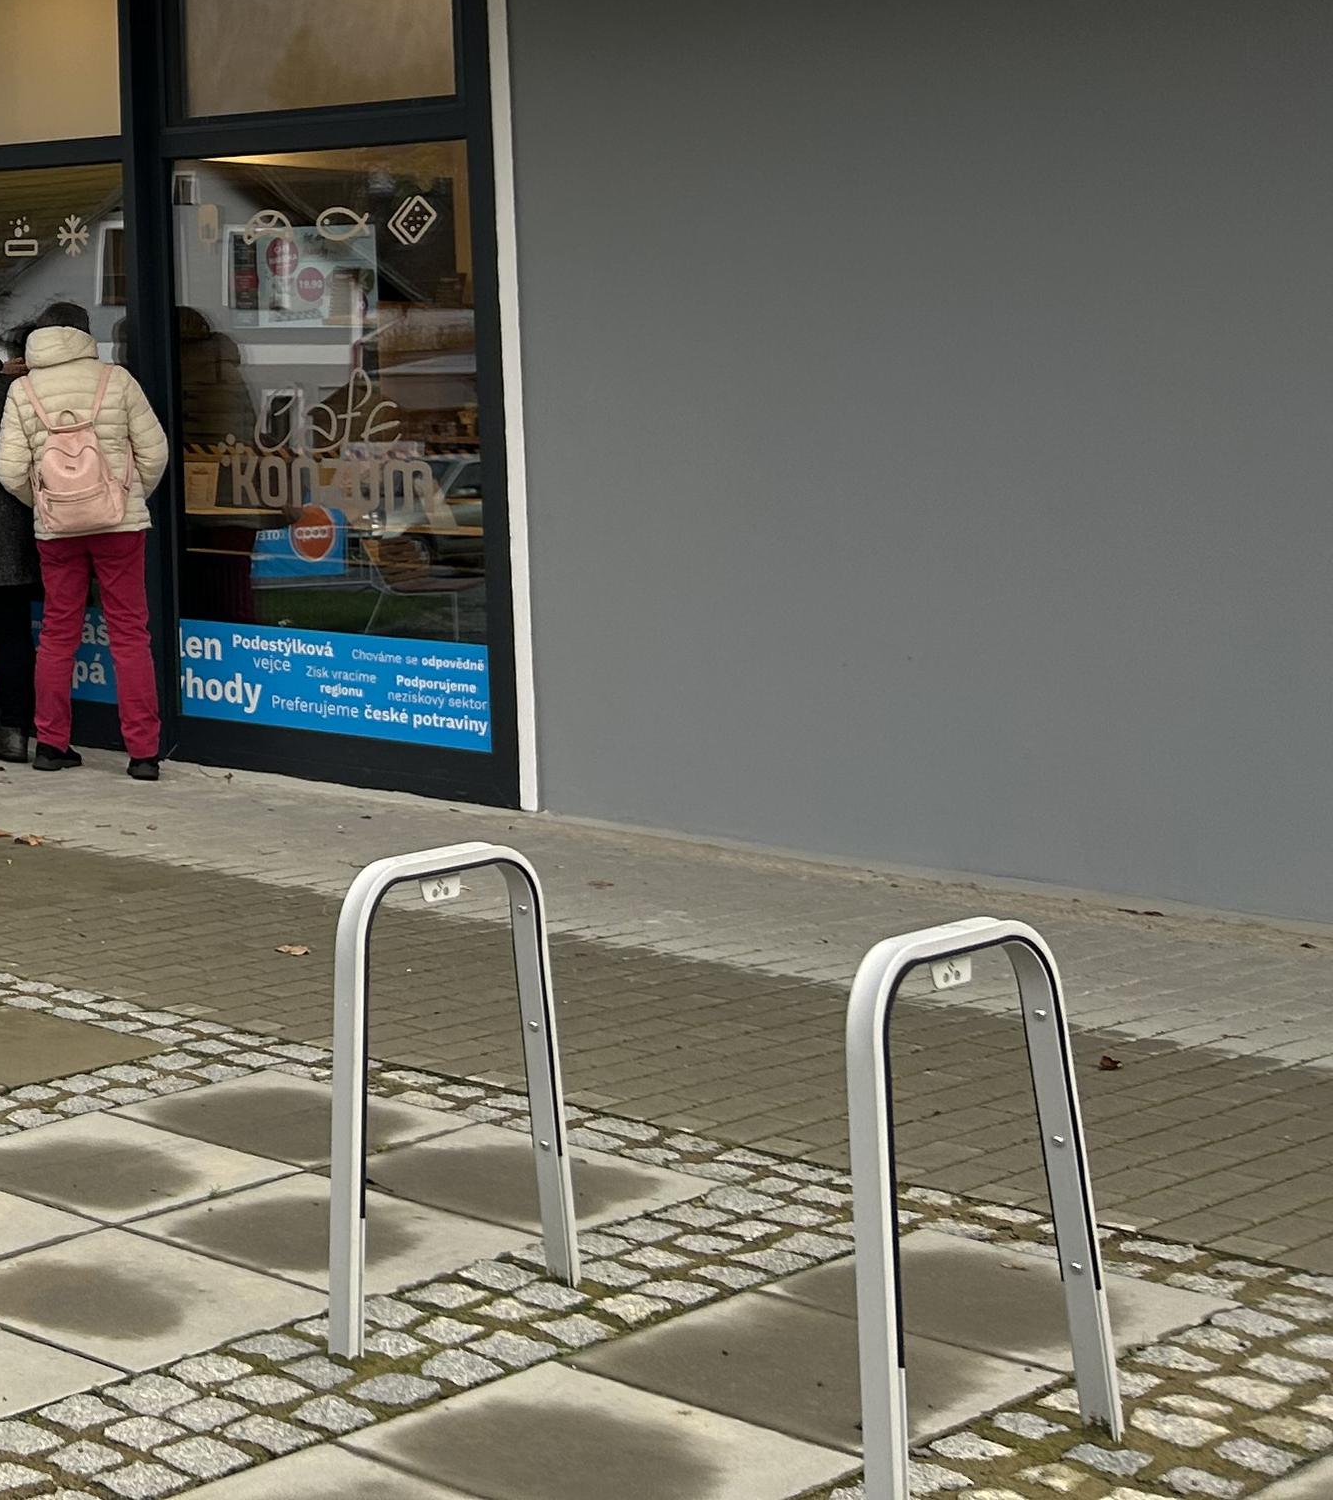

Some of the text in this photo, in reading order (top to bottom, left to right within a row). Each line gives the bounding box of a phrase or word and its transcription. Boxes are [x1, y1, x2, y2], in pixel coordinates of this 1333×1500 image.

[233, 634, 335, 658] Podestýlková
[252, 656, 292, 674] vejce
[351, 649, 485, 672] Chováme se odpovědně
[305, 665, 378, 684] Zisk vracíme
[320, 683, 364, 698] regionu
[396, 675, 477, 695] Podporujeme
[387, 690, 488, 711] neziskový sektor
[271, 695, 489, 737] Preferujeme české potraviny
